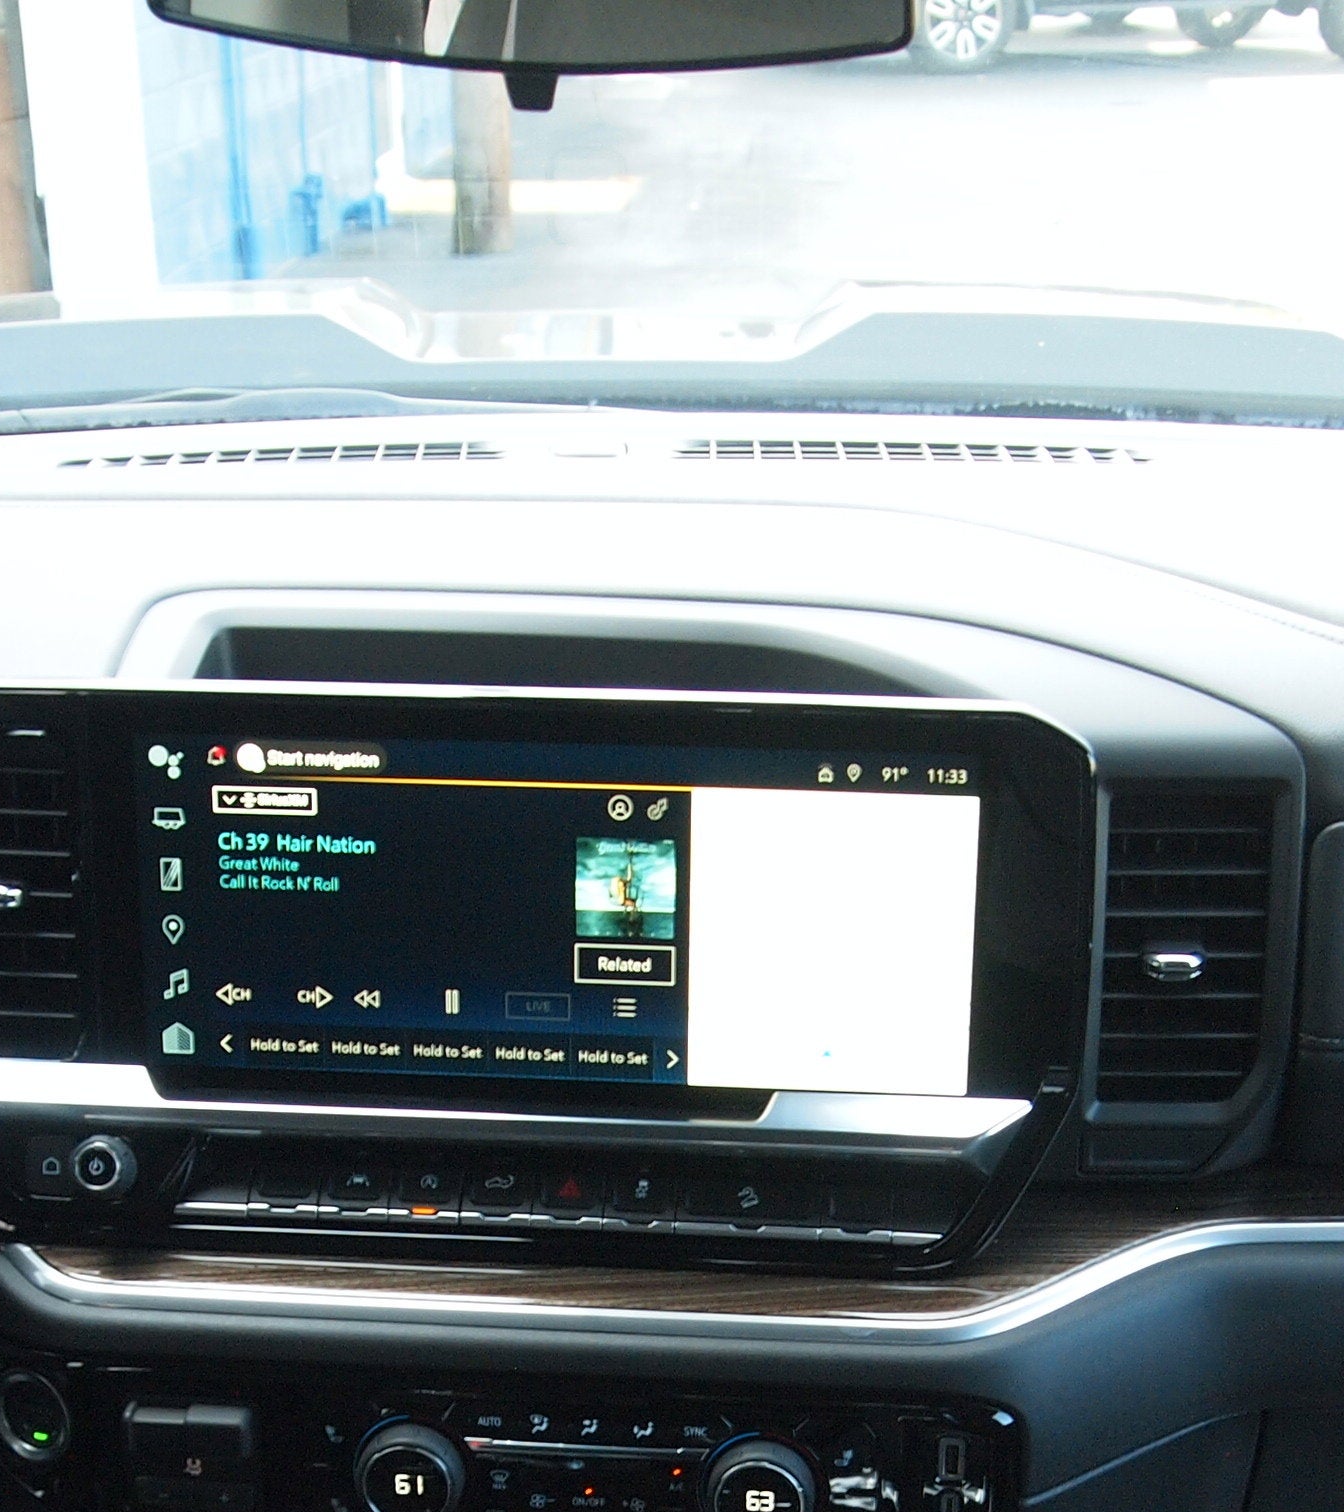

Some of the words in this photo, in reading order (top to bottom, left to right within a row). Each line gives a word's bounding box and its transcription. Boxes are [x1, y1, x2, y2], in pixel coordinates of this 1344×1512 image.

[267, 749, 303, 767] Start
[304, 750, 380, 770] navigation
[926, 767, 969, 786] 11:33
[218, 832, 243, 851] Ch
[246, 833, 269, 851] 39
[277, 834, 314, 853] Hair
[317, 835, 376, 854] Nation
[219, 855, 257, 870] Great
[260, 857, 300, 872] White
[220, 875, 246, 889] Call
[248, 875, 258, 890] It
[261, 875, 295, 890] Rock
[314, 877, 340, 892] Roll
[598, 956, 653, 972] Related
[232, 988, 252, 1001] CH
[297, 990, 316, 1003] CH
[250, 1038, 280, 1052] Hold
[283, 1041, 296, 1052] to
[298, 1040, 319, 1053] Set
[332, 1041, 361, 1054] Hold
[364, 1043, 377, 1055] to
[379, 1043, 400, 1056] Set
[413, 1044, 444, 1057] Hold
[446, 1046, 459, 1057] to
[462, 1045, 483, 1059] Set
[495, 1046, 525, 1060] Hold
[528, 1049, 542, 1061] to
[544, 1048, 565, 1062] Set
[578, 1050, 608, 1063] Hold
[611, 1052, 625, 1064] to
[627, 1051, 648, 1065] Set
[477, 1416, 503, 1428] AUTO
[683, 1426, 708, 1438] SYNC
[394, 1474, 424, 1496] 61
[745, 1490, 775, 1512] 63
